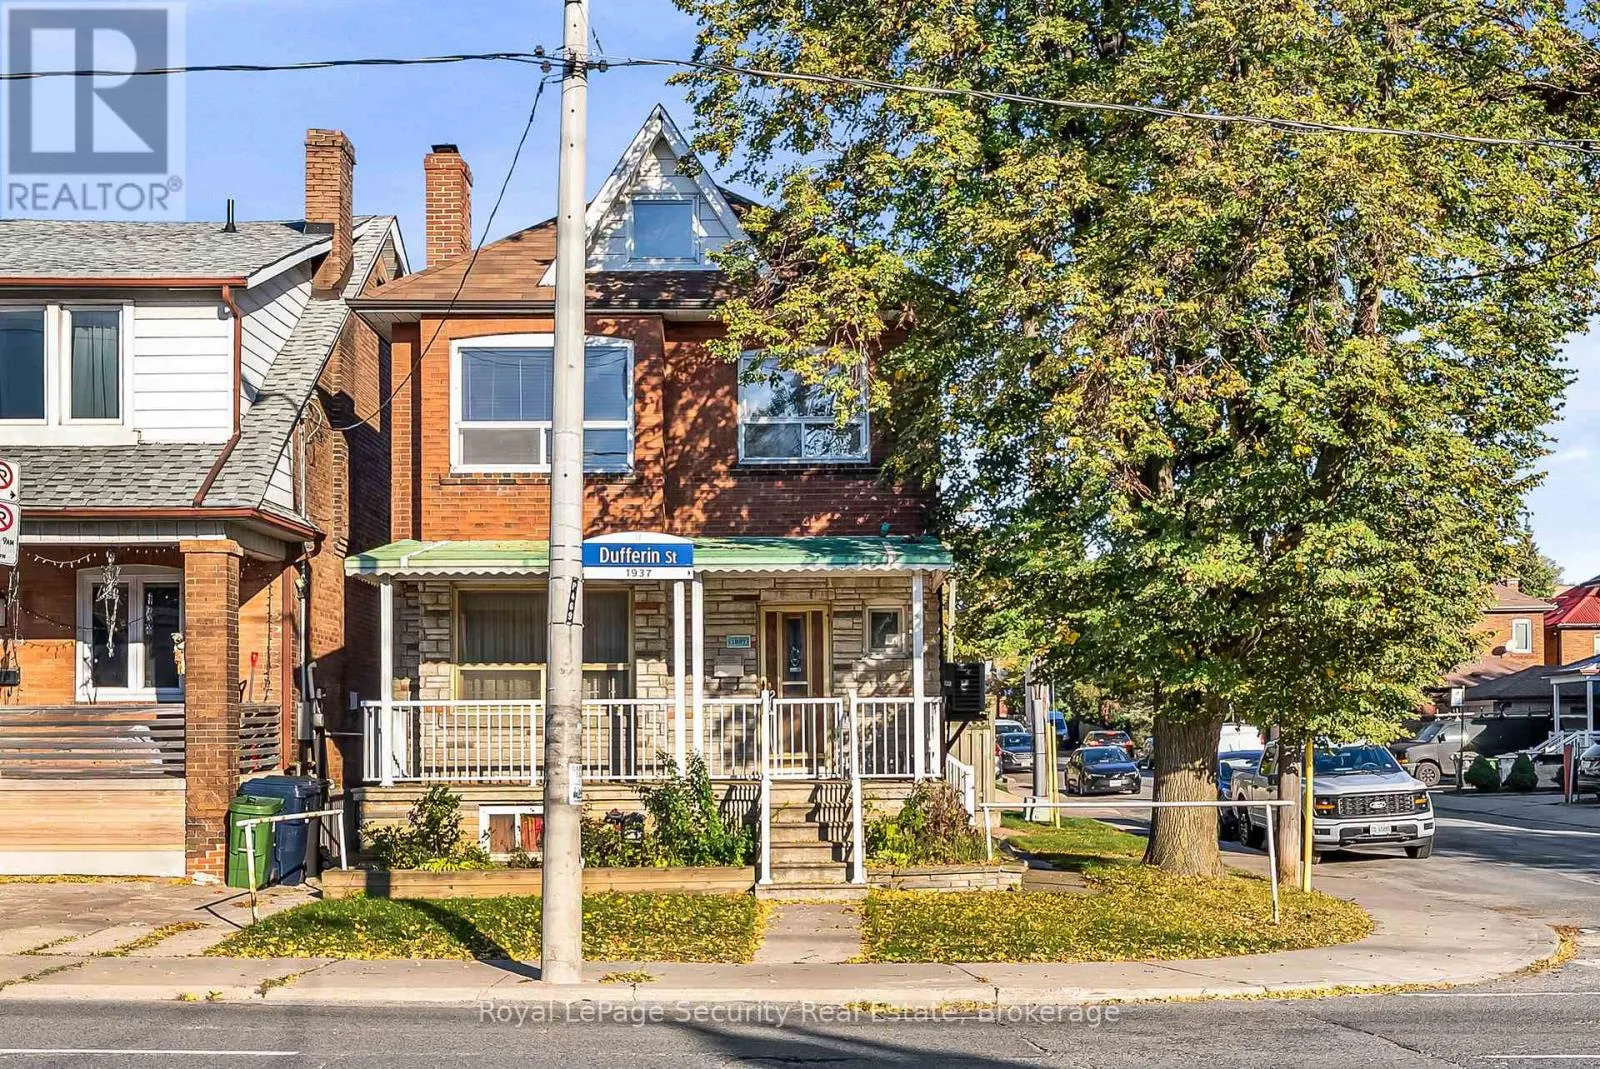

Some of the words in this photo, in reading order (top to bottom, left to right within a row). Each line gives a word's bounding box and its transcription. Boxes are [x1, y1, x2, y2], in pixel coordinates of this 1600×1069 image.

[599, 546, 660, 563] Dufferin
[665, 550, 677, 563] St
[626, 569, 652, 577] 1937
